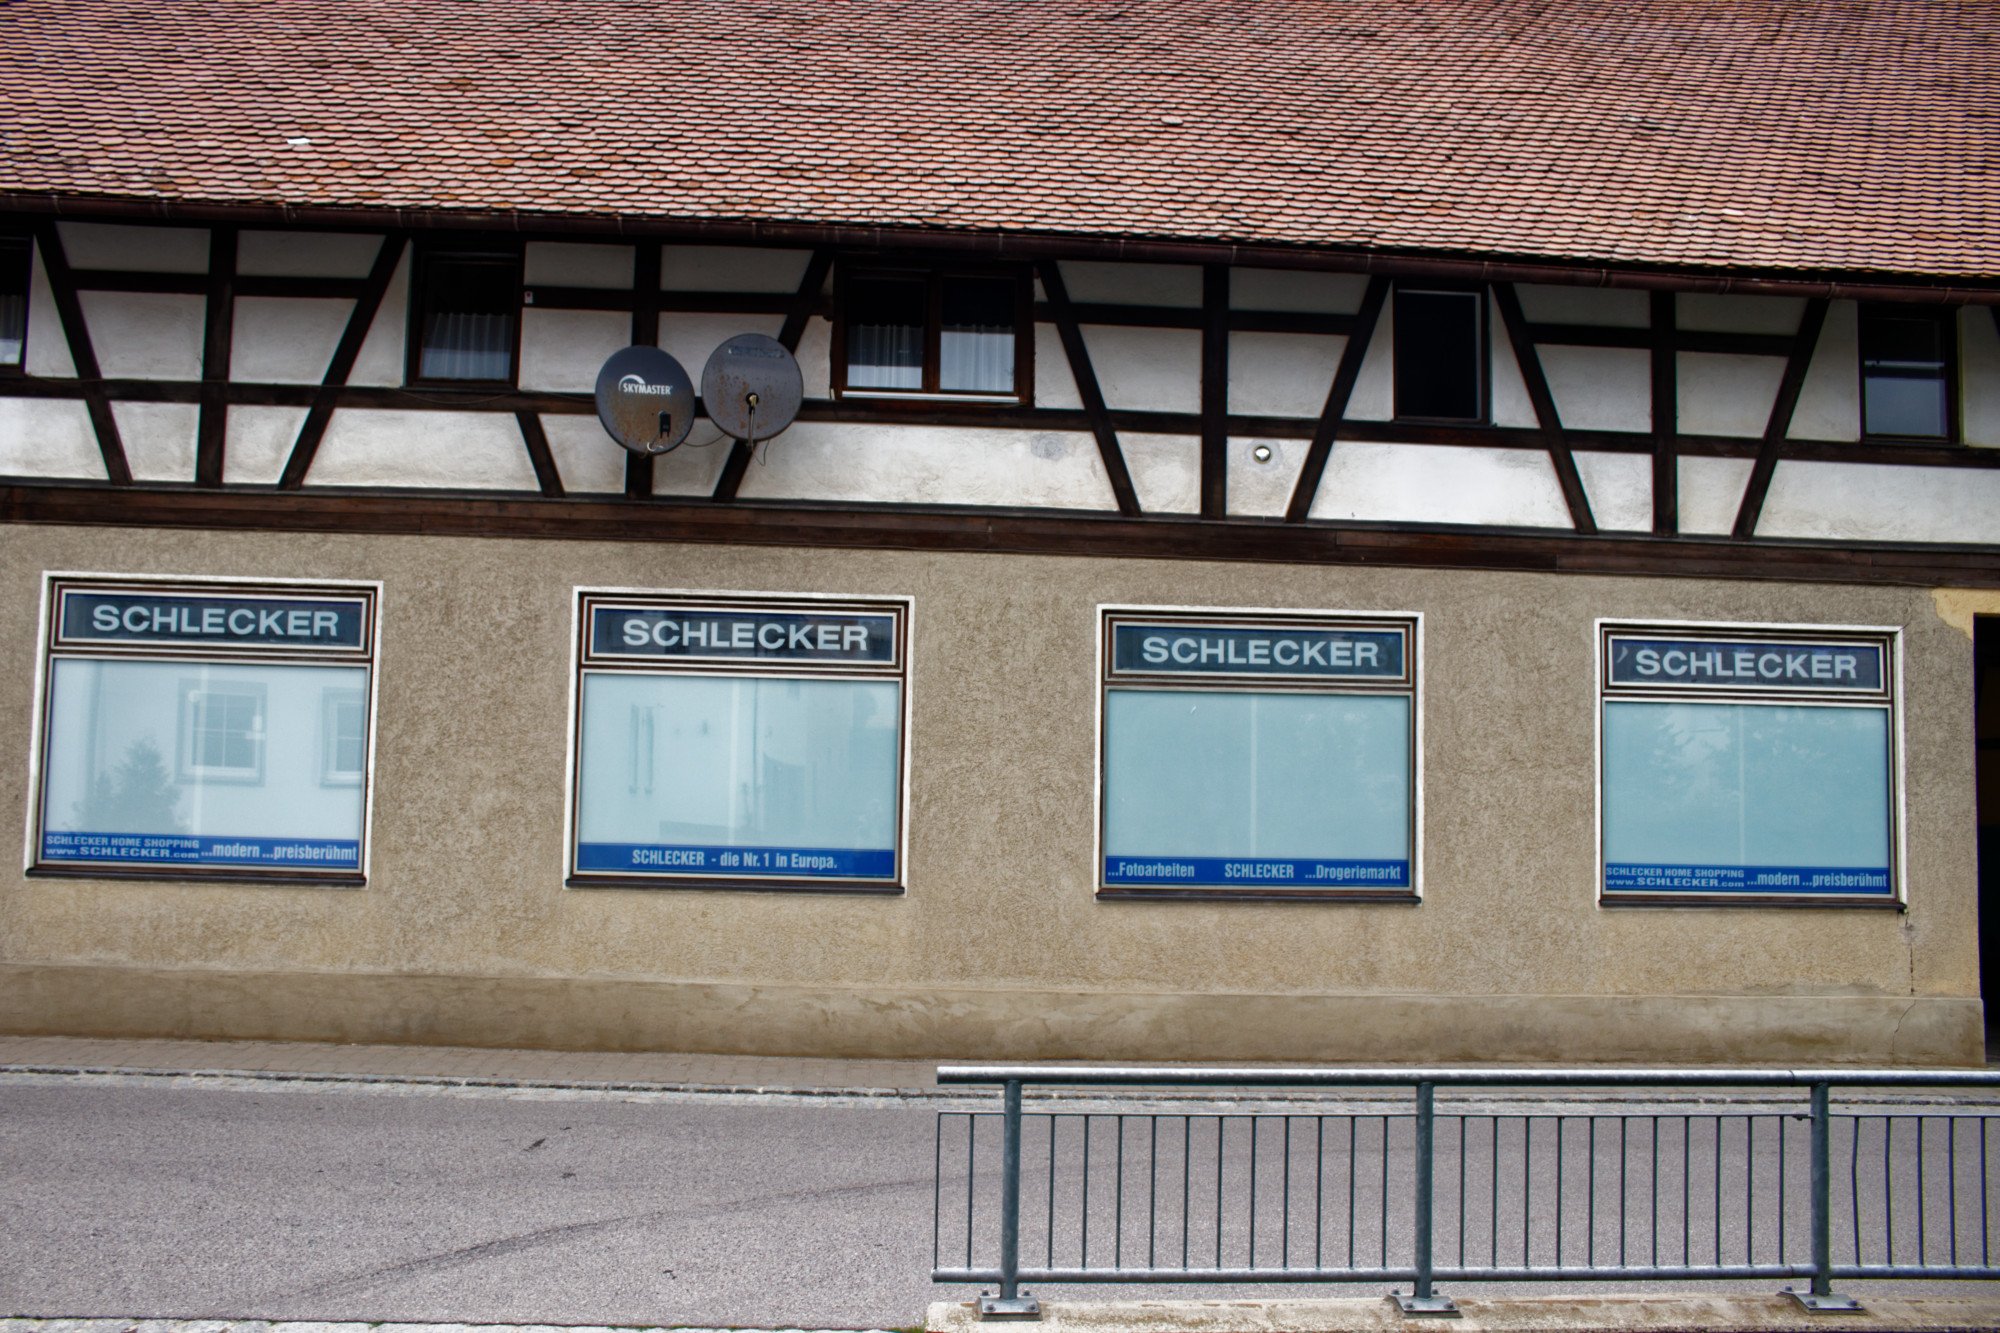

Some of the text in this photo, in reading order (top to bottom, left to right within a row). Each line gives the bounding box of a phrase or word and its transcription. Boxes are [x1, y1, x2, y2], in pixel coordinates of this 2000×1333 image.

[623, 382, 671, 395] SKYMASTER
[92, 604, 339, 637] SCHLECKER
[622, 618, 868, 651] SCHLECKER
[1142, 636, 1379, 667] SCHLECKER
[1635, 649, 1857, 679] SCHLECKER
[46, 835, 200, 849] SCHLECKER HOME SHOPPING
[45, 846, 200, 859] www.SCHLECKER.com
[201, 843, 358, 861] ...modern ...preisberühmt
[632, 849, 705, 866] SCHLECKER
[720, 852, 740, 867] die
[743, 852, 760, 867] Nr.
[763, 853, 769, 868] 1
[775, 853, 788, 868] in
[791, 853, 838, 870] Europa.
[1107, 862, 1401, 881] ...Fotoarbeiten SCHLECKER ...Drogeriemarkt
[1606, 867, 1745, 879] SCHLECKER HOME SHOPPING
[1746, 872, 1887, 888] ...modern ...preisberühmt
[1606, 876, 1745, 888] www.SCHLECKER.com
